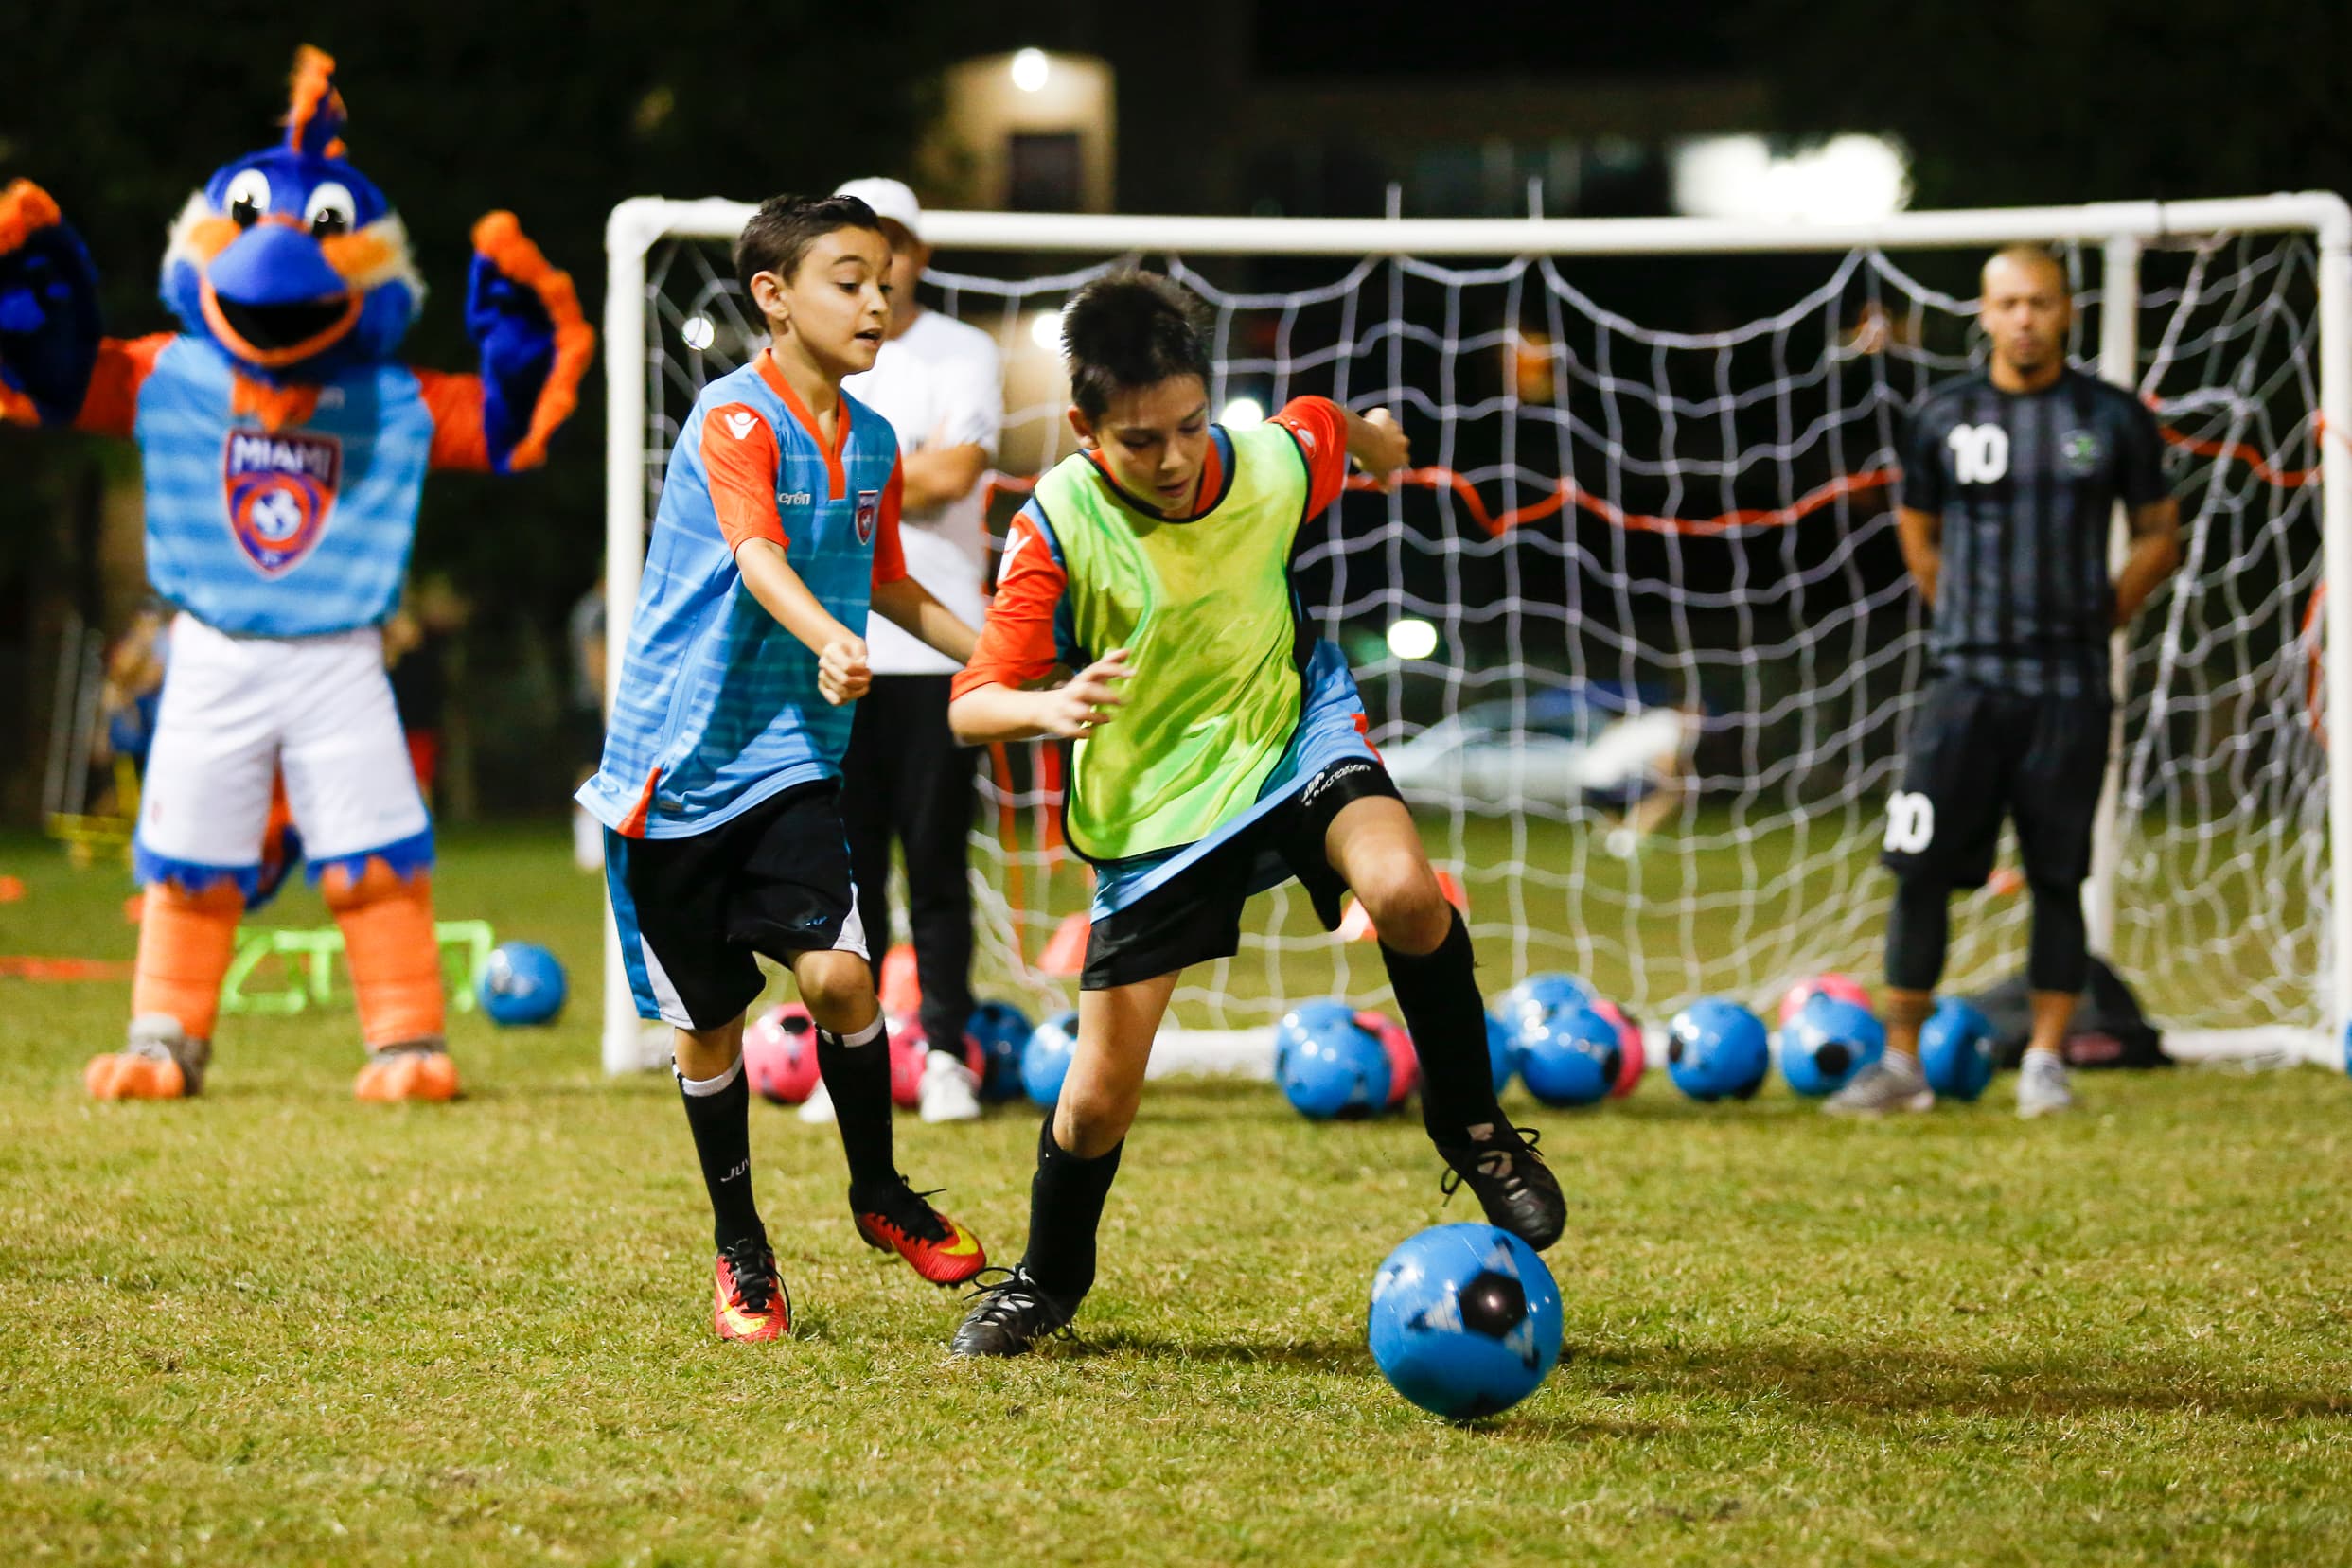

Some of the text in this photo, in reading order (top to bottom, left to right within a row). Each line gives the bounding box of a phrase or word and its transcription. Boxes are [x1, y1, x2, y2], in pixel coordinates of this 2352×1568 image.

[233, 434, 328, 478] MIAMI
[1947, 423, 2009, 484] 10
[1883, 790, 1934, 854] 10
